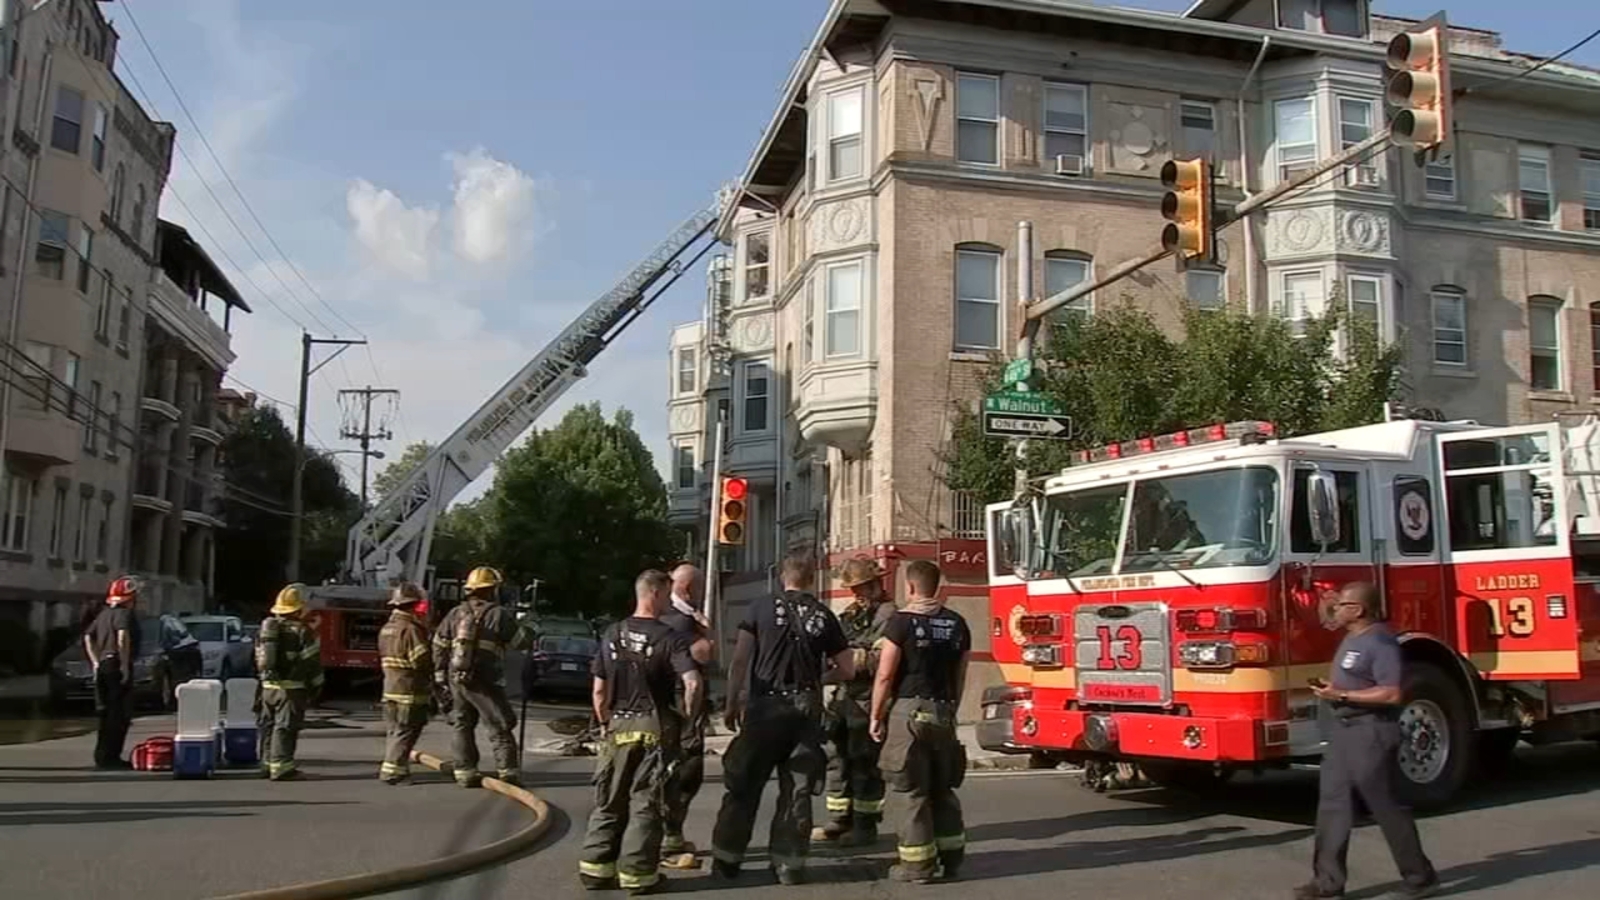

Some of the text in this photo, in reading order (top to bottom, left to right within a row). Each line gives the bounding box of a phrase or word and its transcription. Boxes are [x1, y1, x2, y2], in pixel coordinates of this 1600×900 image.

[998, 398, 1046, 413] Walnut
[994, 419, 1046, 431] ONE WAY
[1476, 574, 1540, 591] LADDER
[1488, 597, 1536, 639] 13
[1096, 625, 1142, 670] 13
